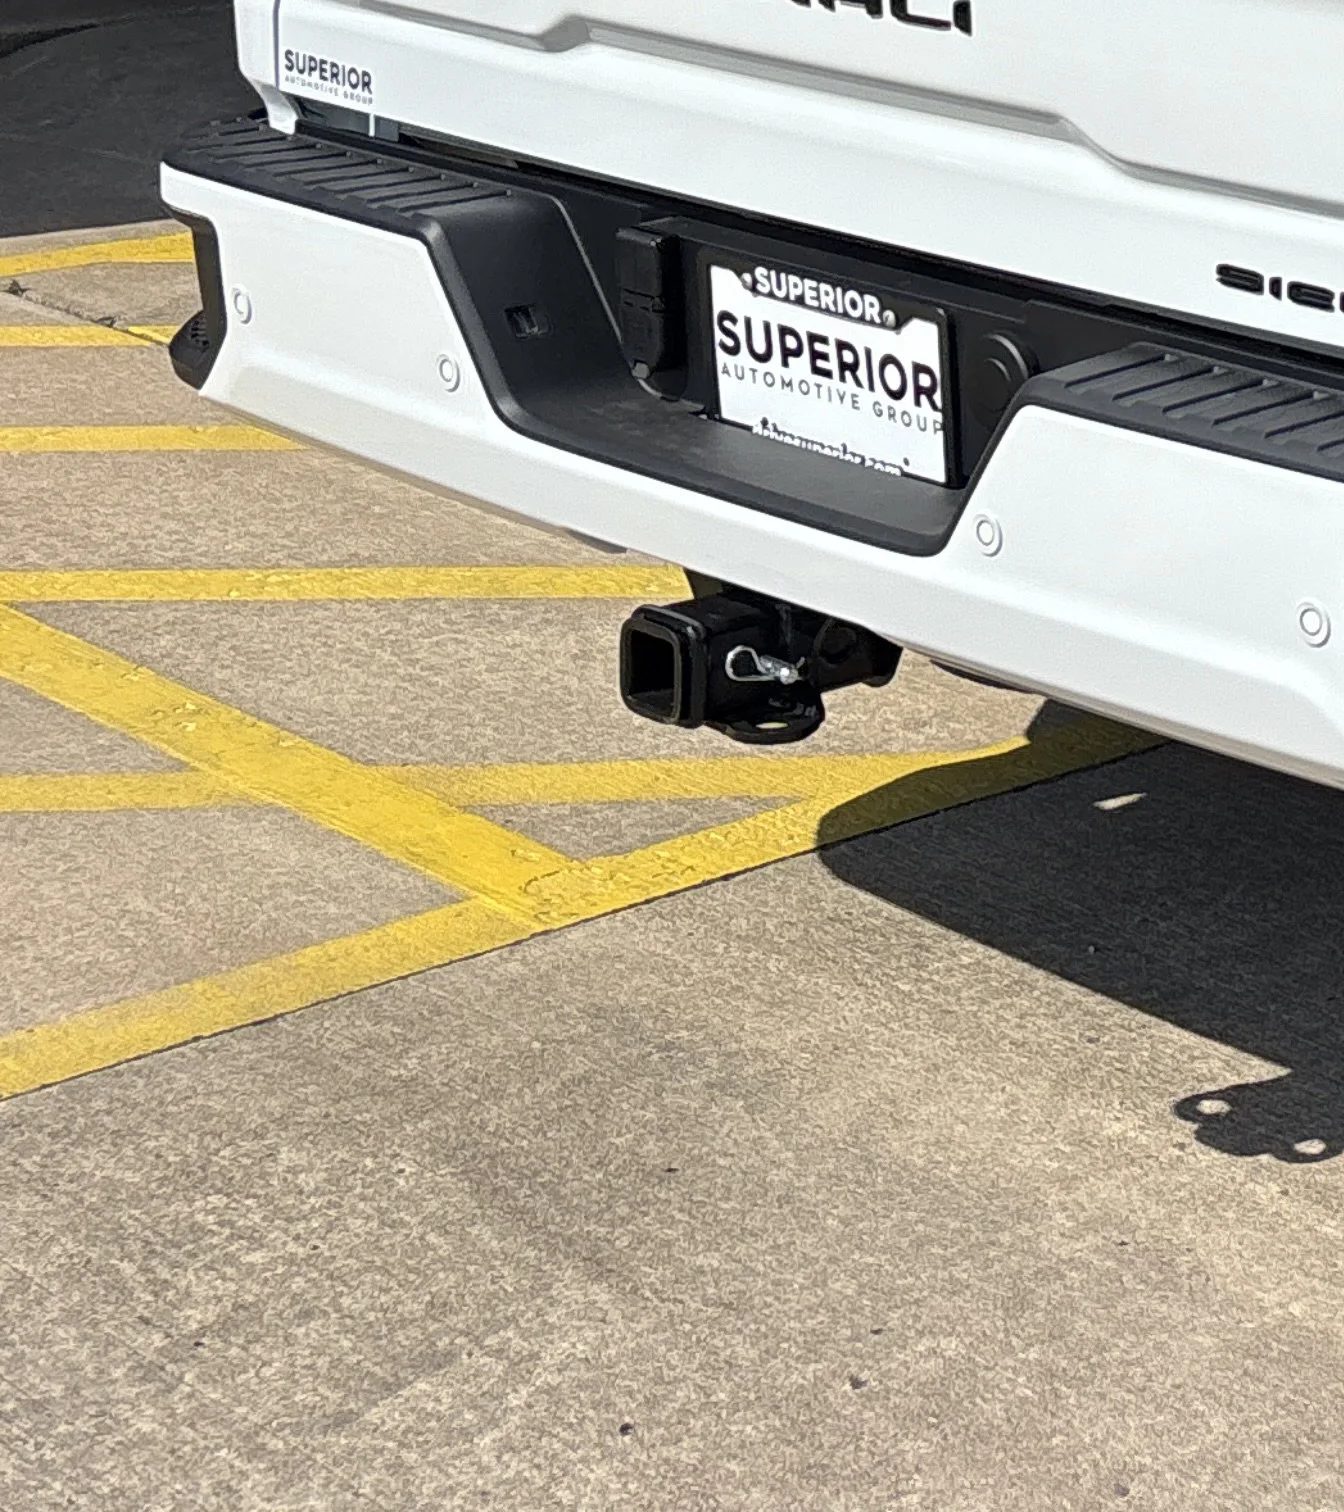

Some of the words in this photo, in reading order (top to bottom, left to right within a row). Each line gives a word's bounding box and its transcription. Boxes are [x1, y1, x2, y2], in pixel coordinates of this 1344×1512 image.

[284, 48, 373, 96] SUPERIOR
[753, 266, 882, 324] SUPERIOR
[716, 309, 943, 413] SUPERIOR
[720, 361, 861, 411] AUTOMOTIVE
[872, 400, 944, 436] GROUP
